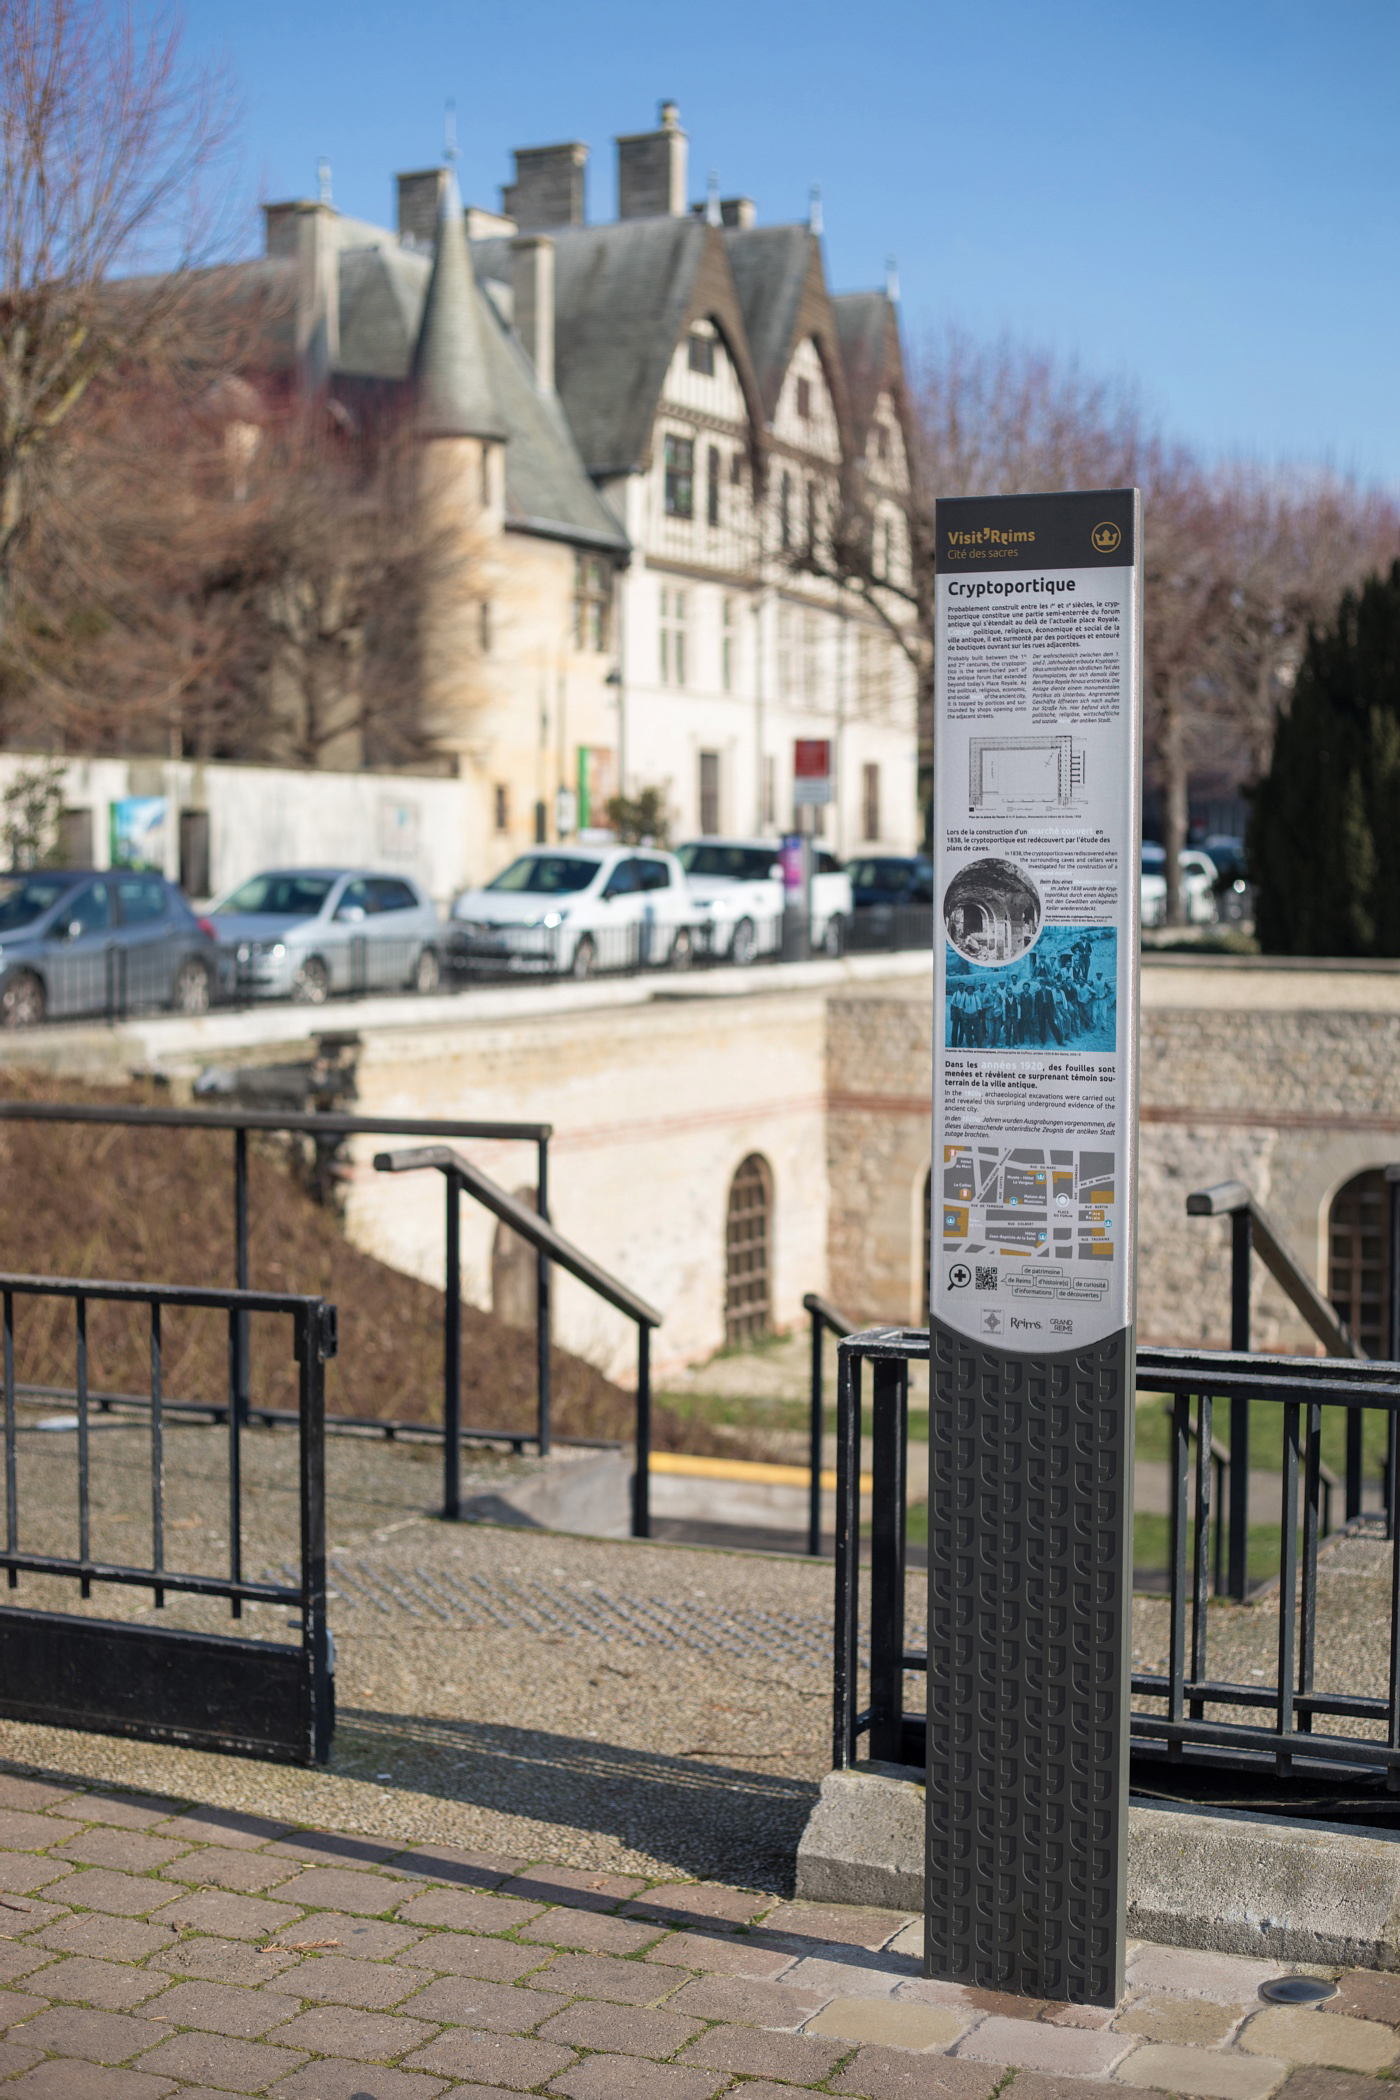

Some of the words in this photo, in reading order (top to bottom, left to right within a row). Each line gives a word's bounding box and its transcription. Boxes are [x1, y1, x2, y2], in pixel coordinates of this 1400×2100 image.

[948, 528, 1035, 544] Visit'Reims
[948, 549, 967, 559] Cité
[969, 548, 986, 558] des
[948, 577, 1076, 598] Cryptoportique
[982, 1060, 1017, 1069] années
[1021, 1062, 1044, 1071] 1920,
[1028, 1072, 1069, 1081] surprenant
[1008, 1081, 1037, 1090] antique.
[985, 1091, 1027, 1099] archaeological
[997, 1099, 1026, 1107] surprising
[1027, 1100, 1066, 1109] underground
[1010, 1318, 1041, 1330] Reims
